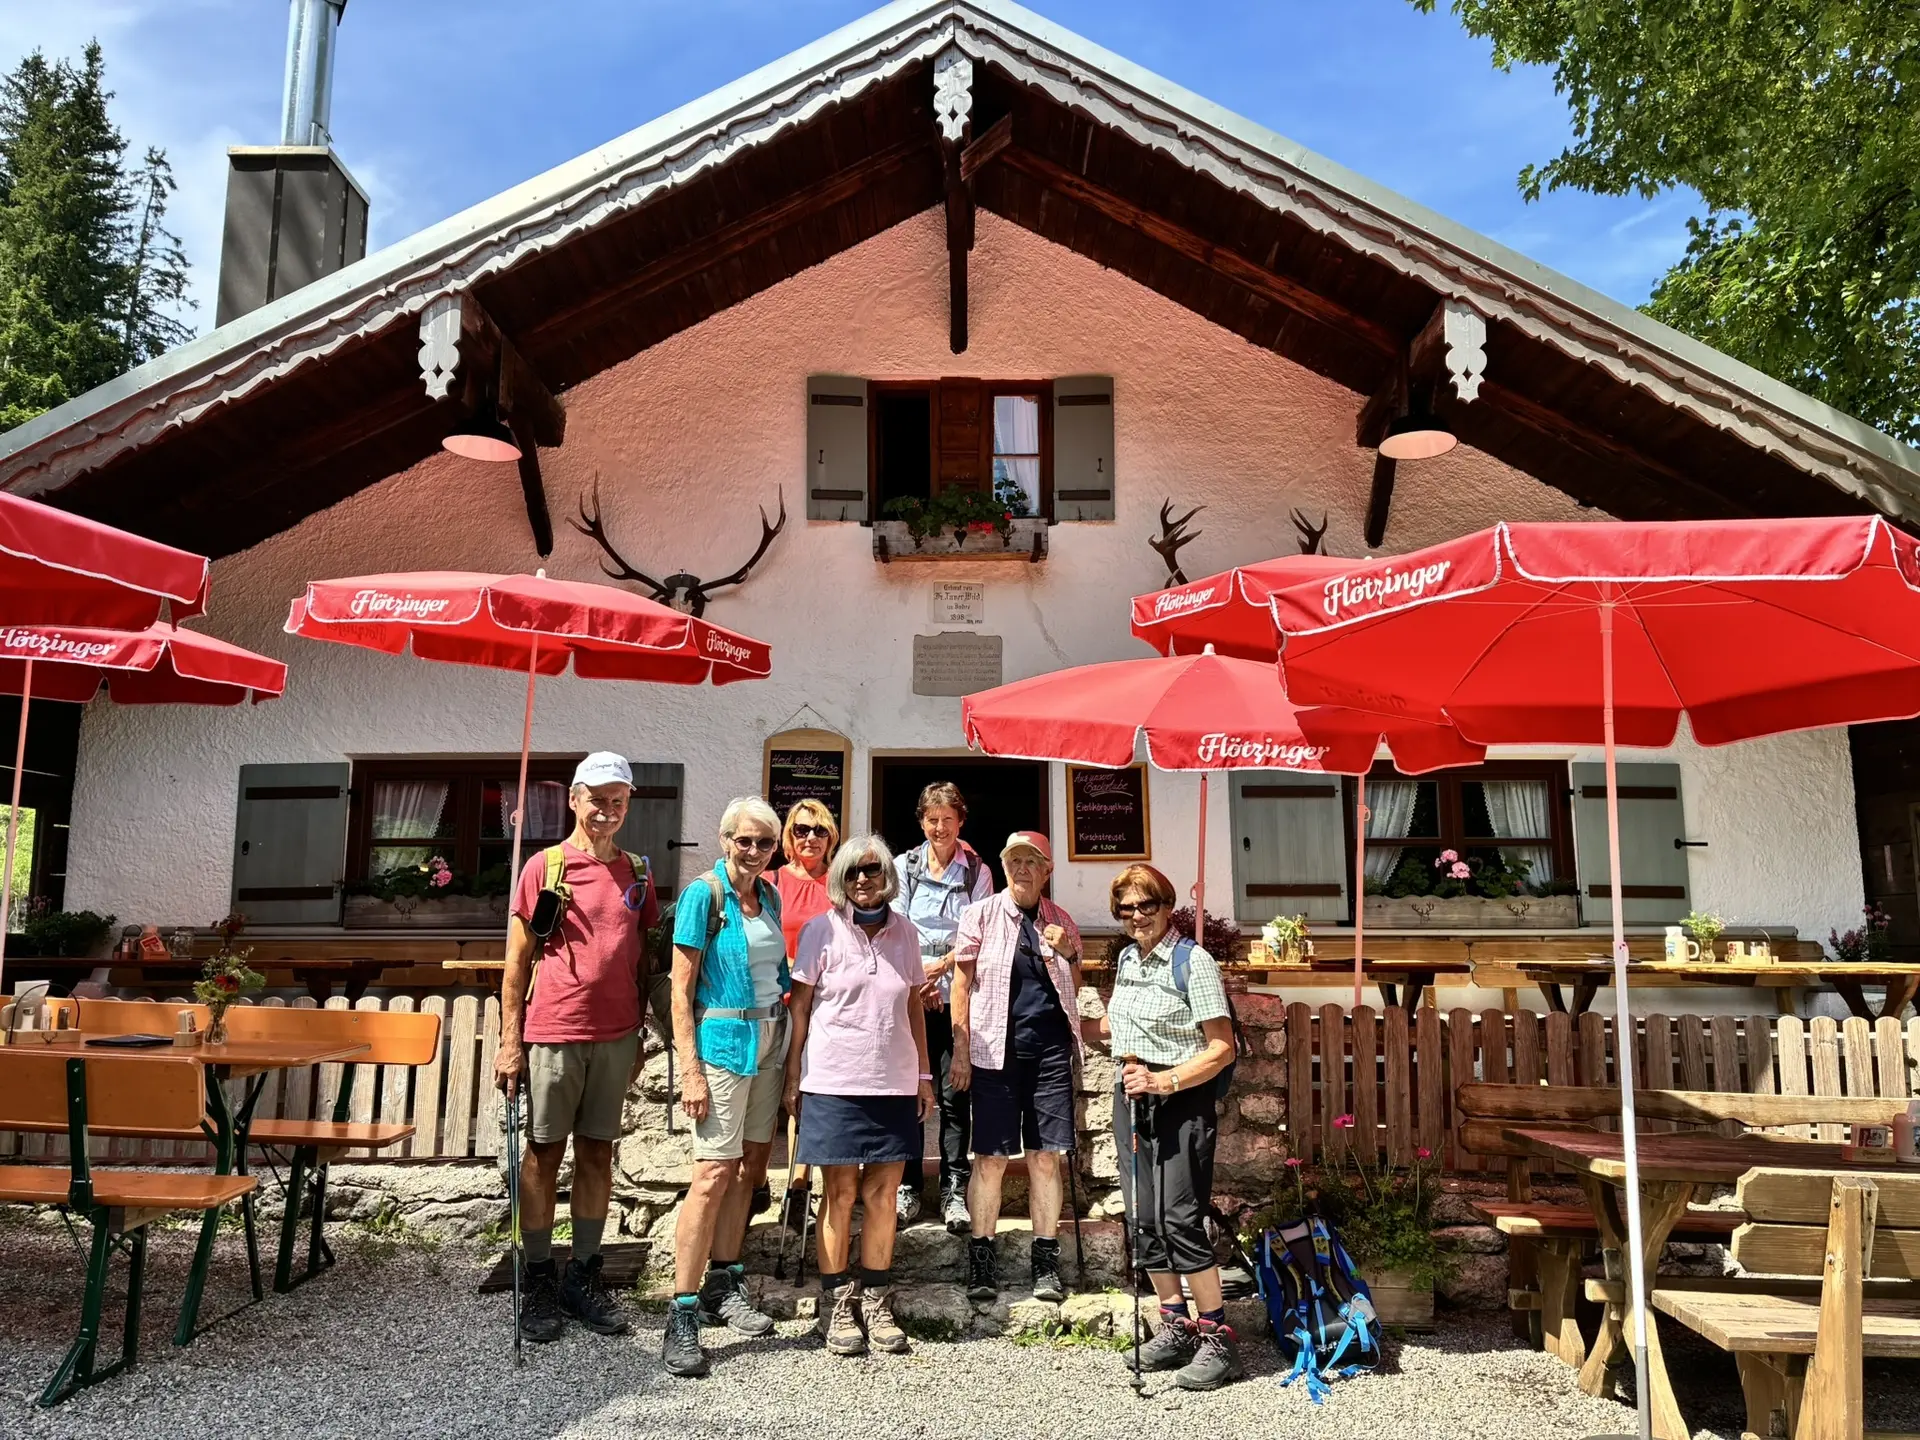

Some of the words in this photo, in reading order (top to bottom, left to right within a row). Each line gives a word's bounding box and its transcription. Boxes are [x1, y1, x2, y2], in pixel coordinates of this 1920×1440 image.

[350, 590, 450, 617] Flötzinger
[1155, 587, 1216, 617] Flötzinger
[1323, 561, 1451, 616] Flötzinger
[0, 629, 116, 658] lötzinger
[706, 630, 751, 662] Flötzinger
[1197, 732, 1330, 765] Flötzinger
